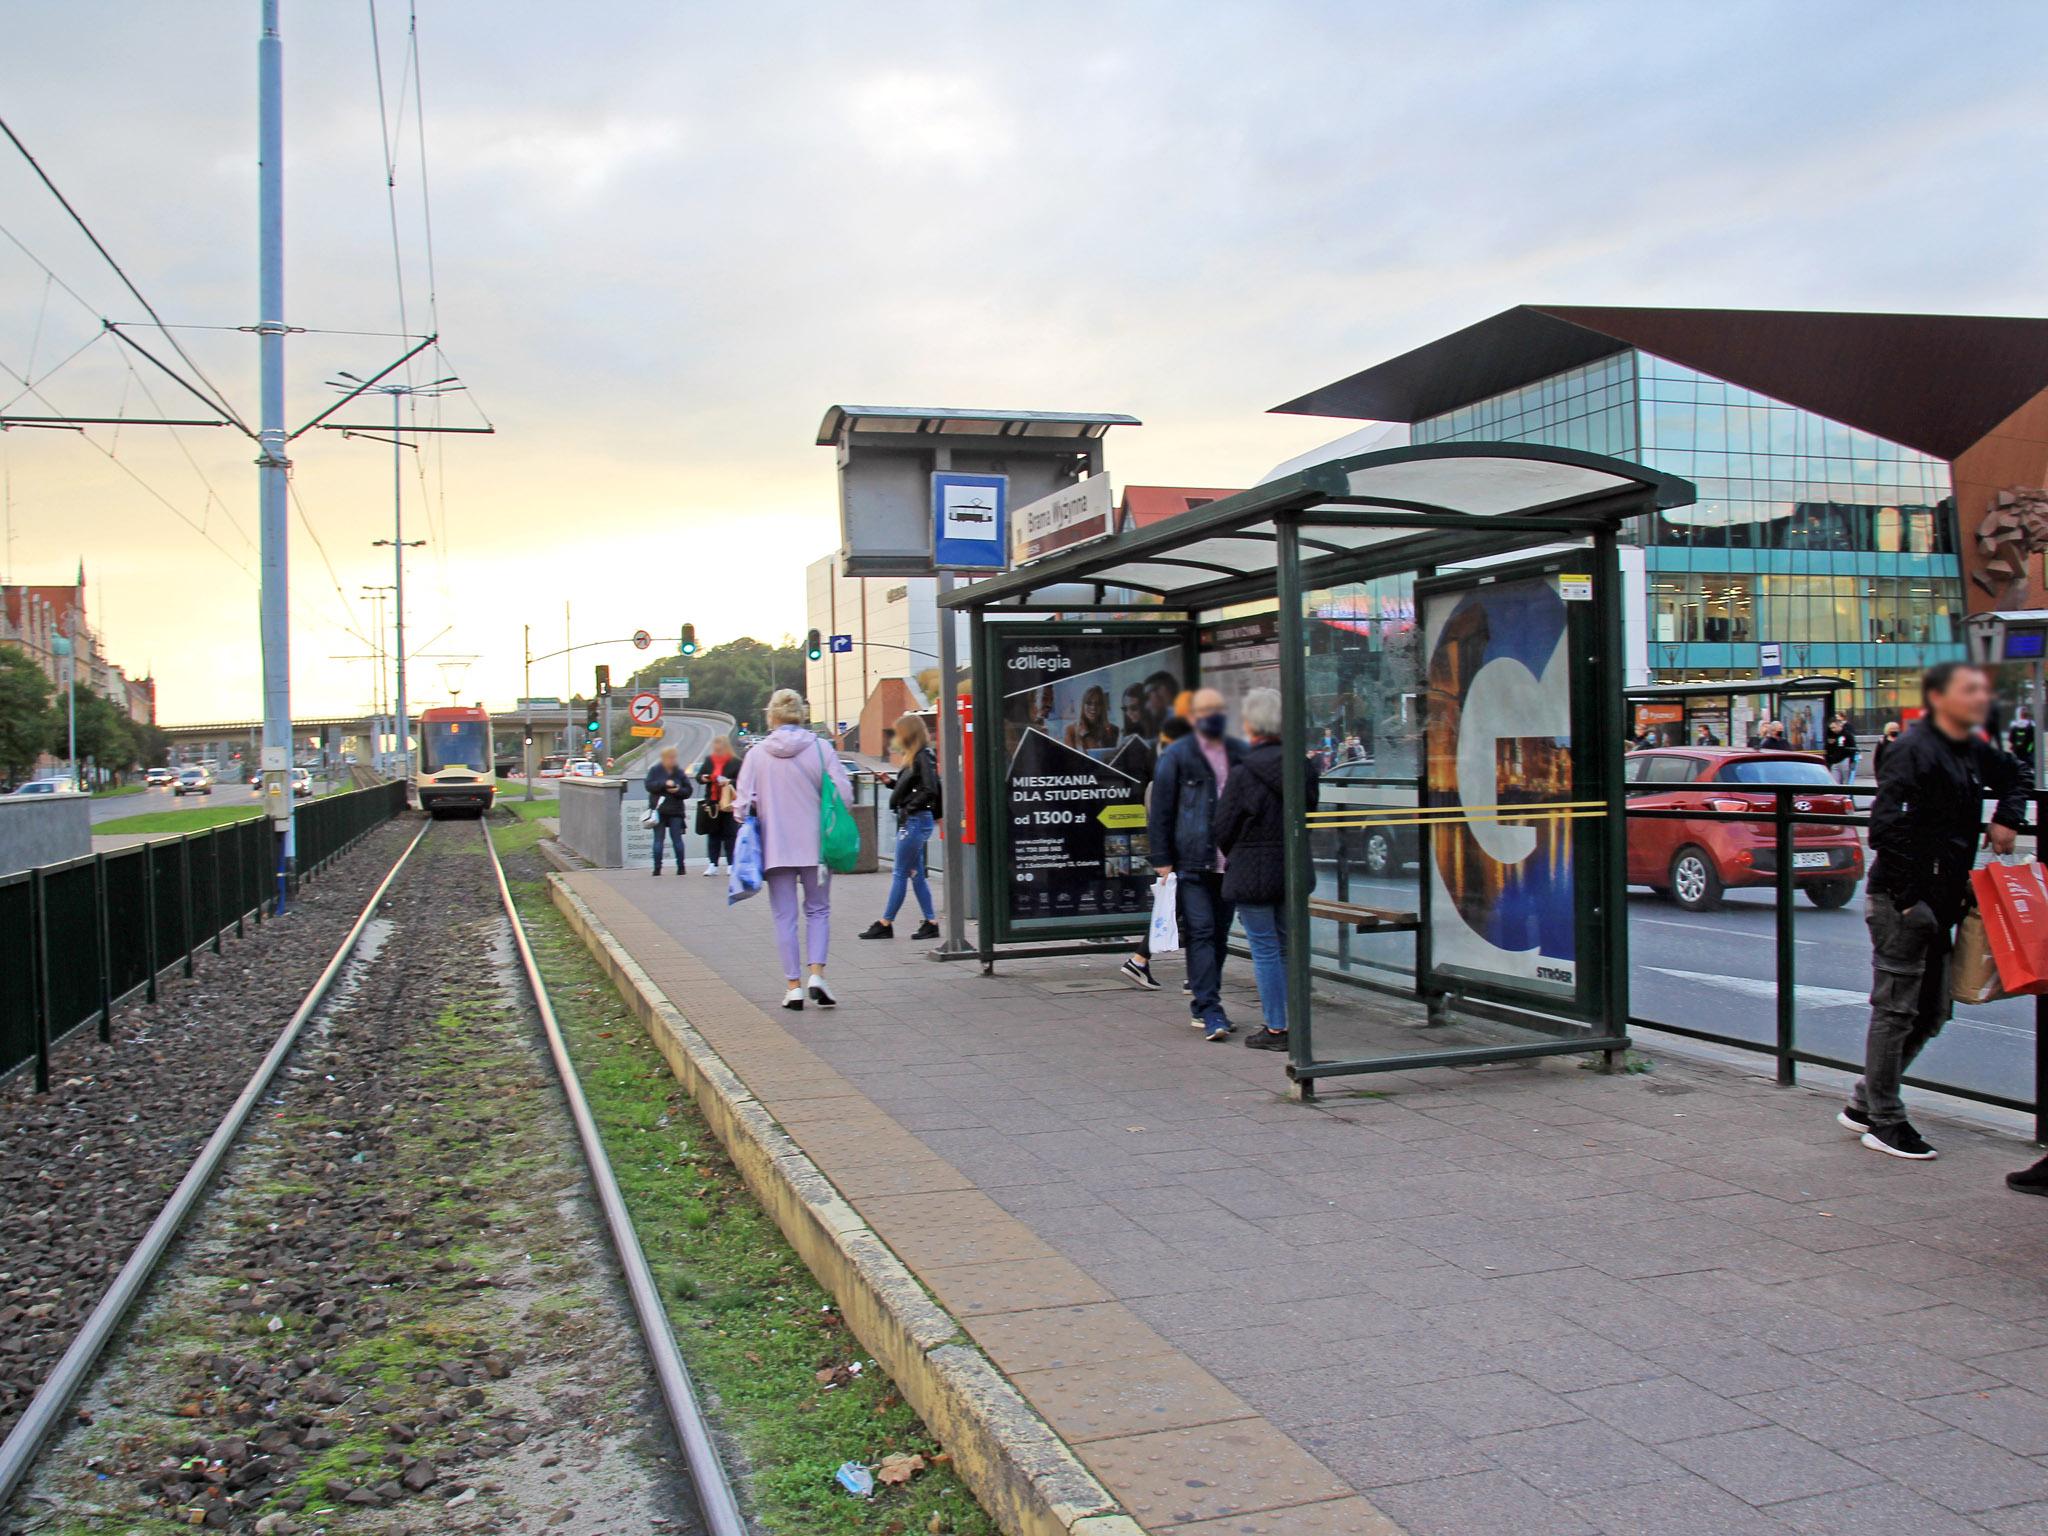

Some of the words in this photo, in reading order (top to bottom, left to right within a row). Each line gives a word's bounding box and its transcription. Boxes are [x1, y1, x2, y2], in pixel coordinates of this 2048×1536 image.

[1028, 510, 1051, 532] Brama
[1012, 775, 1098, 788] MIESZKANIA
[1013, 790, 1043, 802] DLA
[1044, 785, 1131, 801] STUDENTÓW
[1014, 815, 1030, 825] od
[1033, 810, 1073, 825] 1300
[1074, 812, 1087, 824] zł
[1536, 966, 1573, 984] STRÖER
